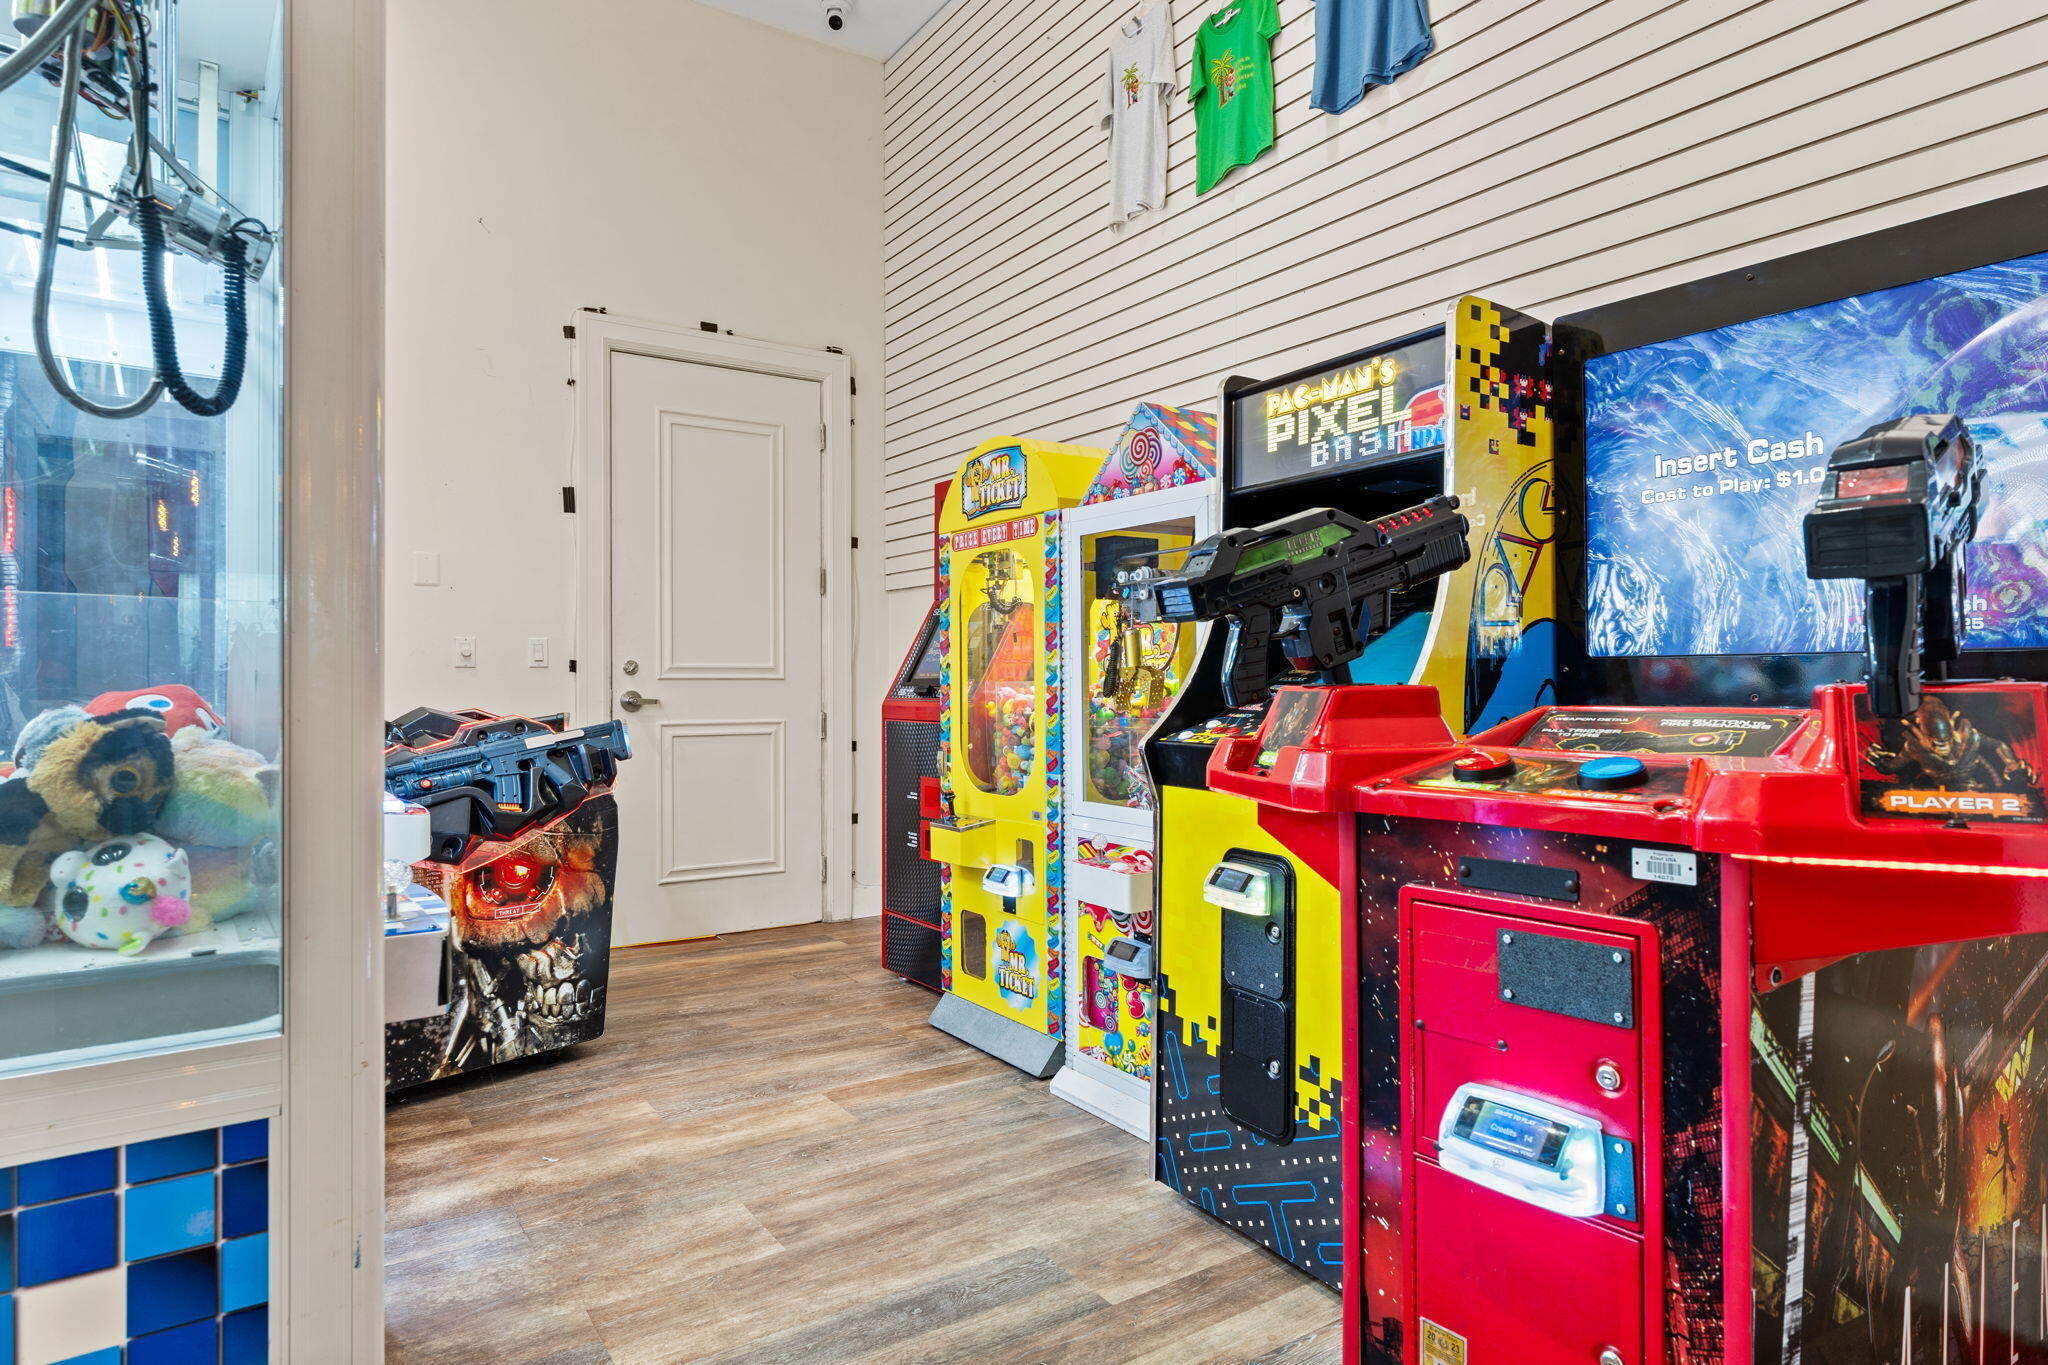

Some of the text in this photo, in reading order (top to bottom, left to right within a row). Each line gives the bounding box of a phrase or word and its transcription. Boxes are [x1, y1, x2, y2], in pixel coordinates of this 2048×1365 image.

[1266, 357, 1397, 419] PAC-MAN'S
[1267, 386, 1413, 453] PIXEL
[1311, 419, 1412, 468] BASH
[1654, 431, 1824, 478] Insert Cash
[990, 453, 1015, 481] MR.
[979, 474, 1021, 508] TICKET
[1641, 466, 1826, 505] Cost to Play: $1.0
[1012, 517, 1037, 539] TIME
[1889, 795, 2021, 812] PLAYER 2
[499, 908, 520, 916] THREAT
[1009, 950, 1030, 977] MR.
[998, 966, 1035, 999] TICKET
[1490, 1122, 1517, 1138] Credits
